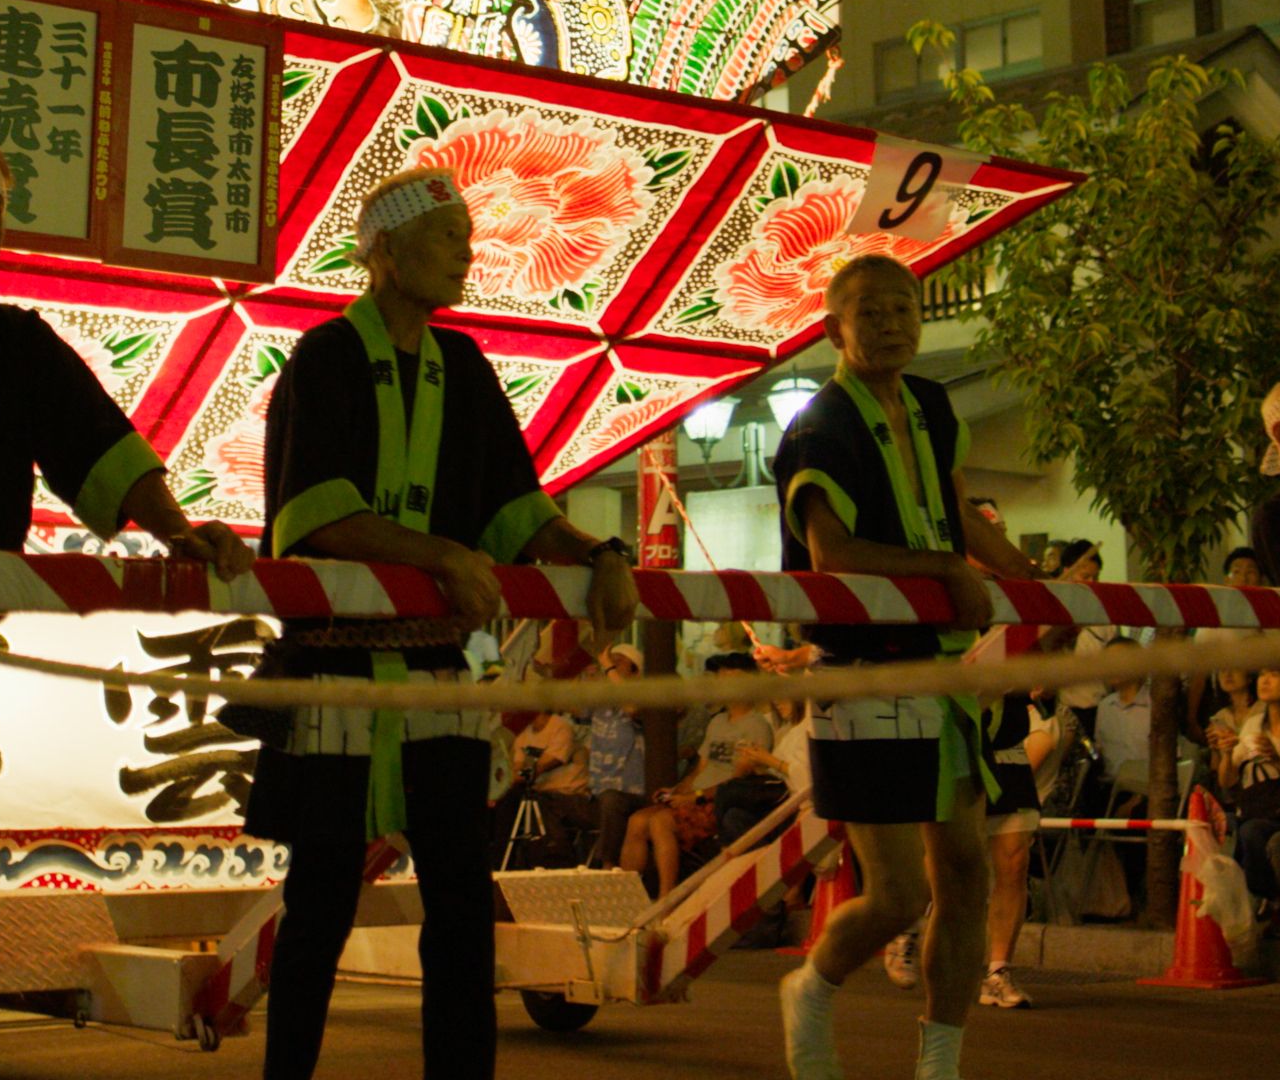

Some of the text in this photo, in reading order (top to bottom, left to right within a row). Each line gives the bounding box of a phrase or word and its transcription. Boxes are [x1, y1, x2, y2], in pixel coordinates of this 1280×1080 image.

[44, 21, 88, 164] 三十一年
[143, 39, 225, 250] 市長賞
[224, 53, 257, 234] 友好都市太田市
[877, 151, 943, 229] 9
